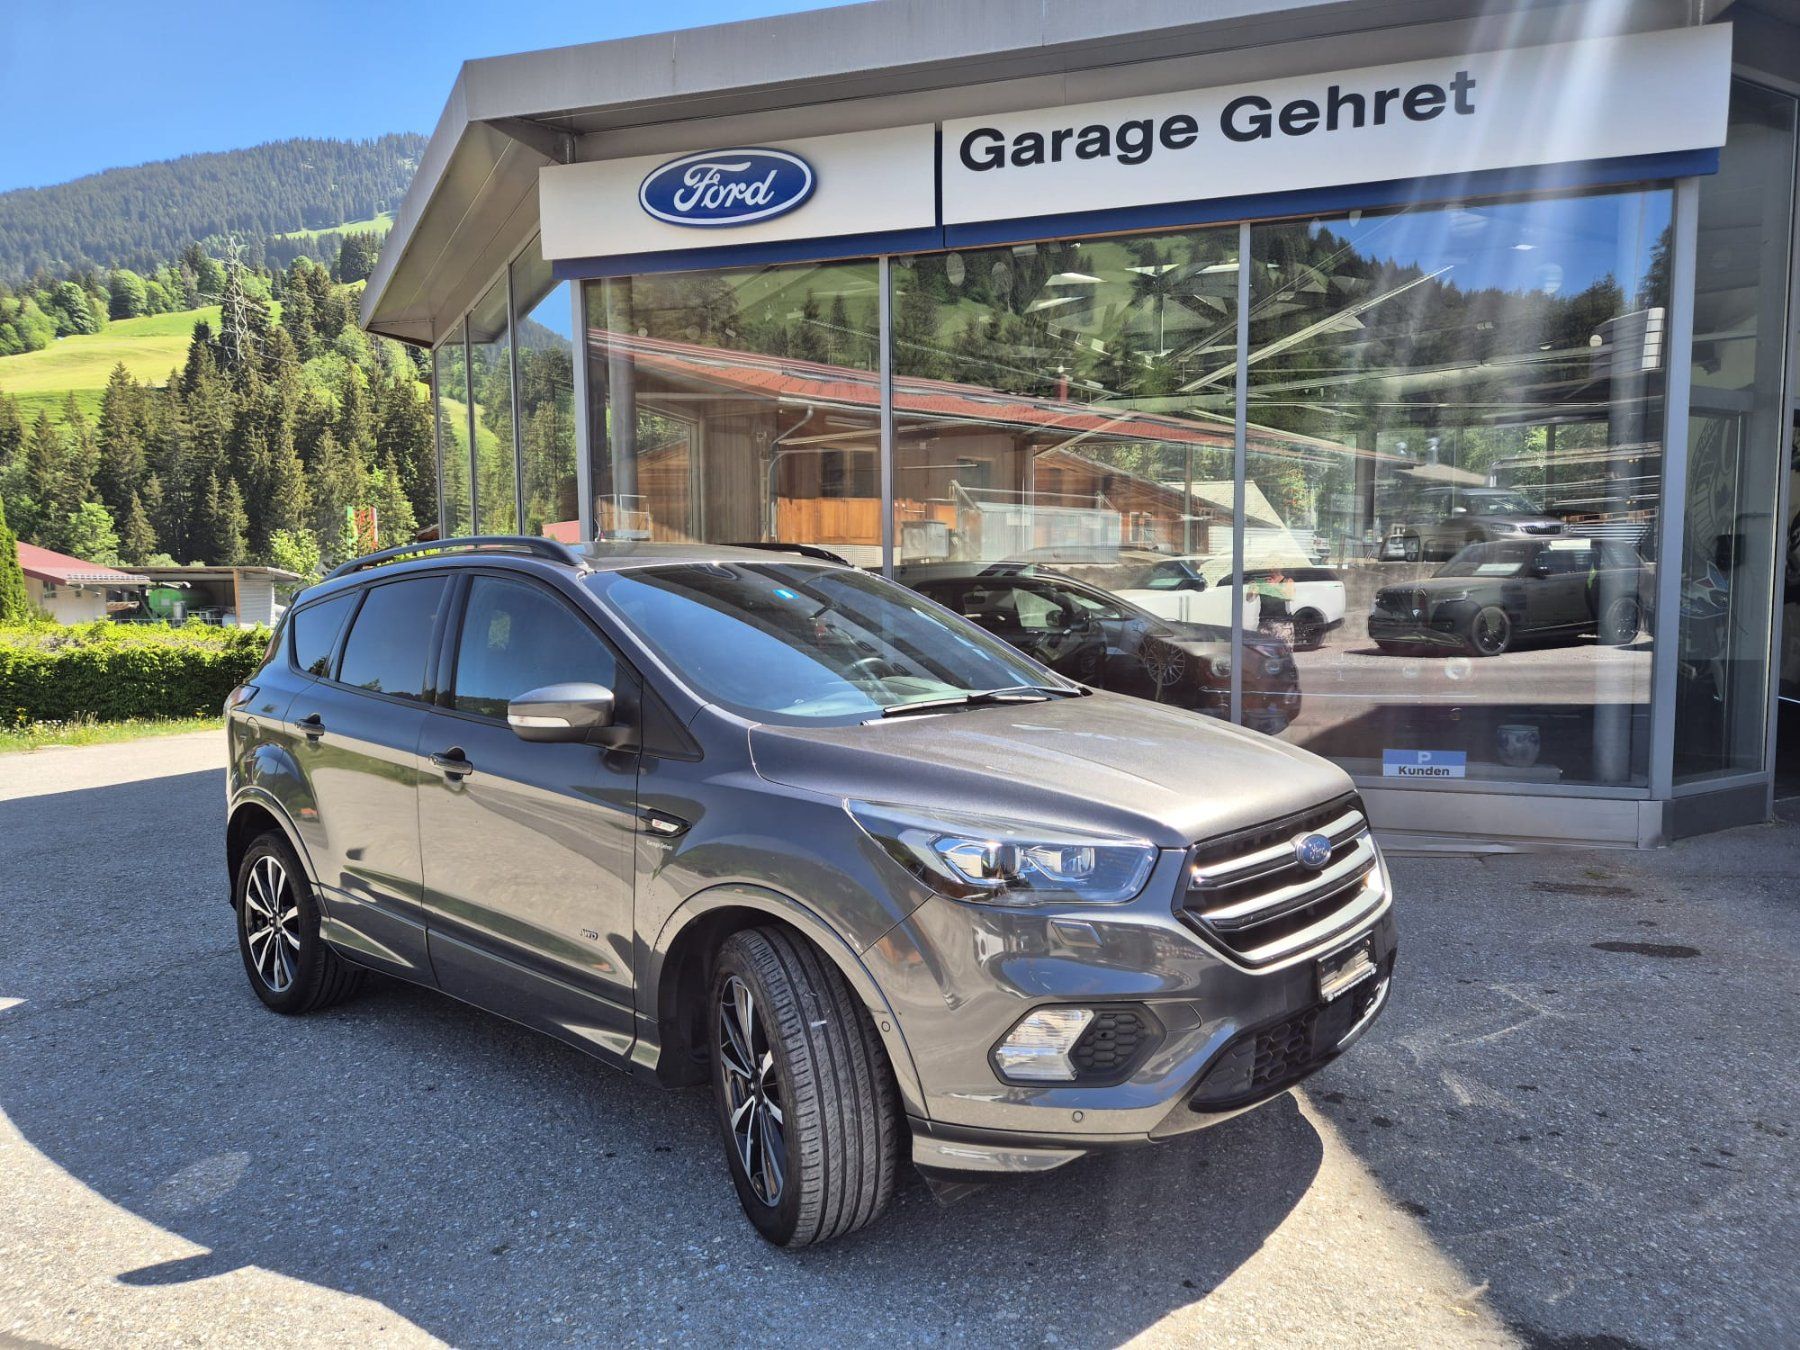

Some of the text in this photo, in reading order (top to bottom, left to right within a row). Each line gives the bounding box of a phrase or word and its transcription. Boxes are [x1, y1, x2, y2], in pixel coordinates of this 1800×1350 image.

[959, 70, 1477, 172] Garage Gehret
[673, 161, 778, 212] Ford
[1398, 765, 1450, 776] Kunden
[1417, 751, 1432, 764] P
